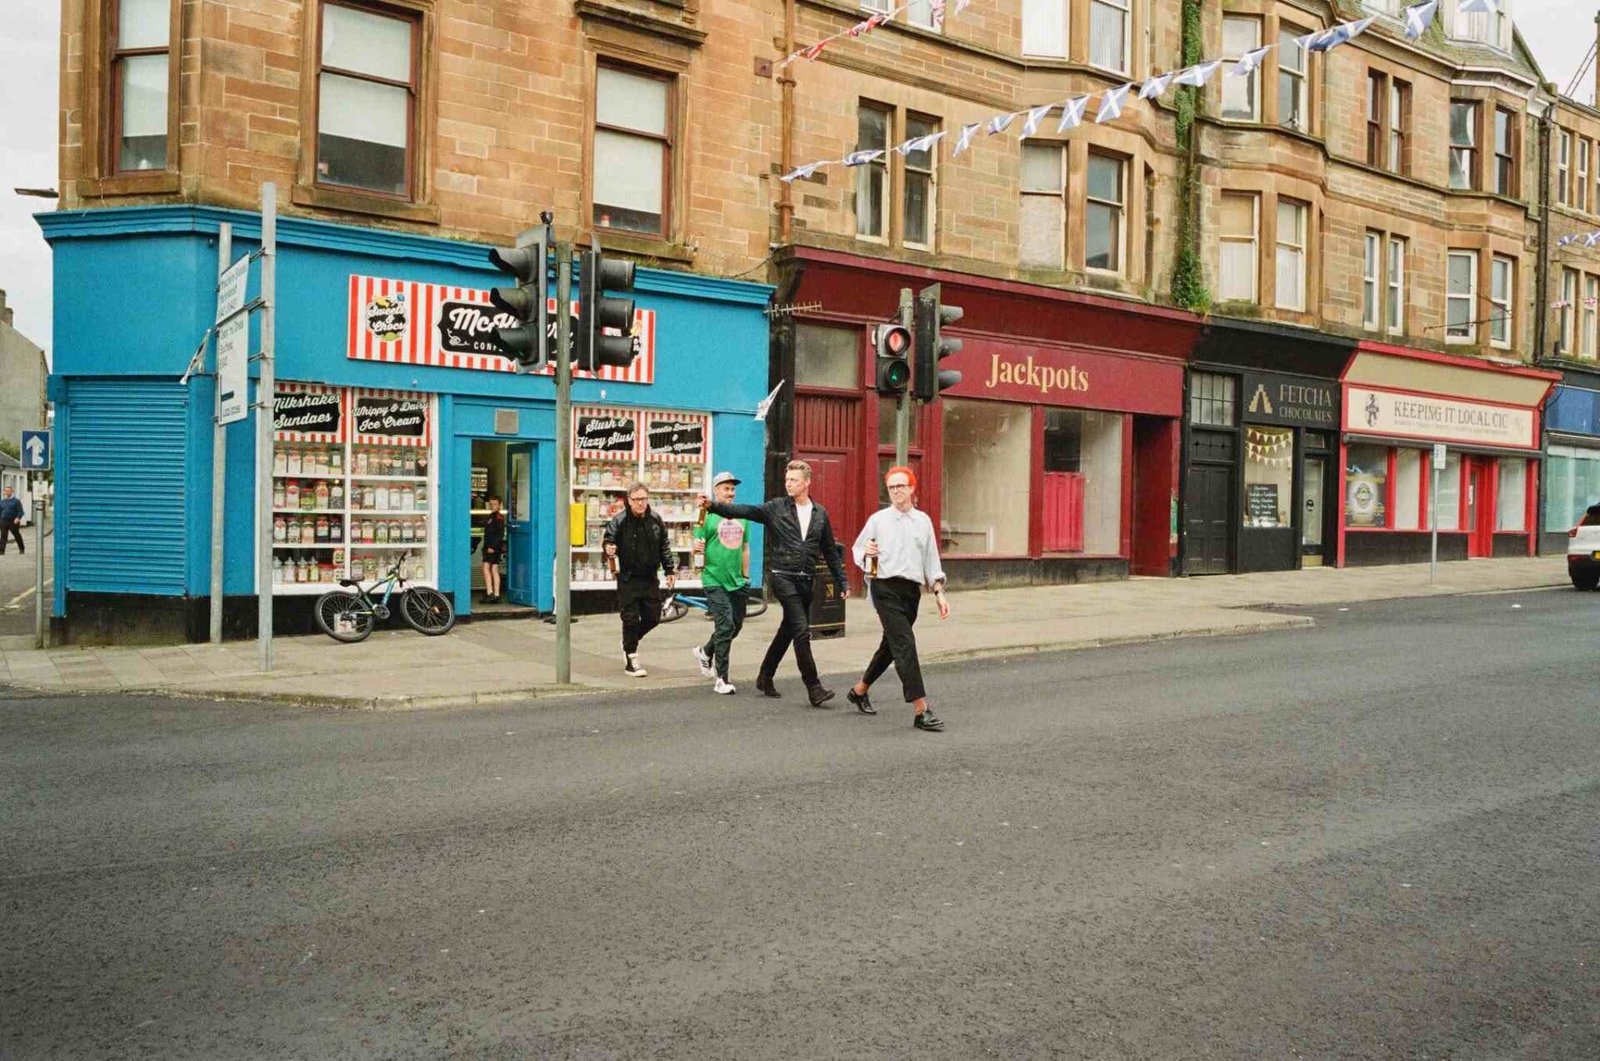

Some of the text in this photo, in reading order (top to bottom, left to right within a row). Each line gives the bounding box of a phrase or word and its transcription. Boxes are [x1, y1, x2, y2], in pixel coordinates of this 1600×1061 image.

[372, 321, 404, 332] Chocs
[985, 354, 1089, 393] Jackpots
[1279, 384, 1332, 407] FETCHA
[351, 406, 389, 416] Whippy
[400, 401, 429, 412] Dairy
[1279, 406, 1333, 422] CHOCOLATES
[1394, 401, 1442, 421] KEEPING
[1444, 407, 1456, 423] IT
[1457, 409, 1491, 425] LOCAL
[1492, 413, 1509, 429] CIC
[274, 413, 332, 429] Sundaes
[359, 415, 421, 431] Ice Cream
[586, 418, 617, 434] Slush
[576, 431, 639, 449] Fizzy Slush
